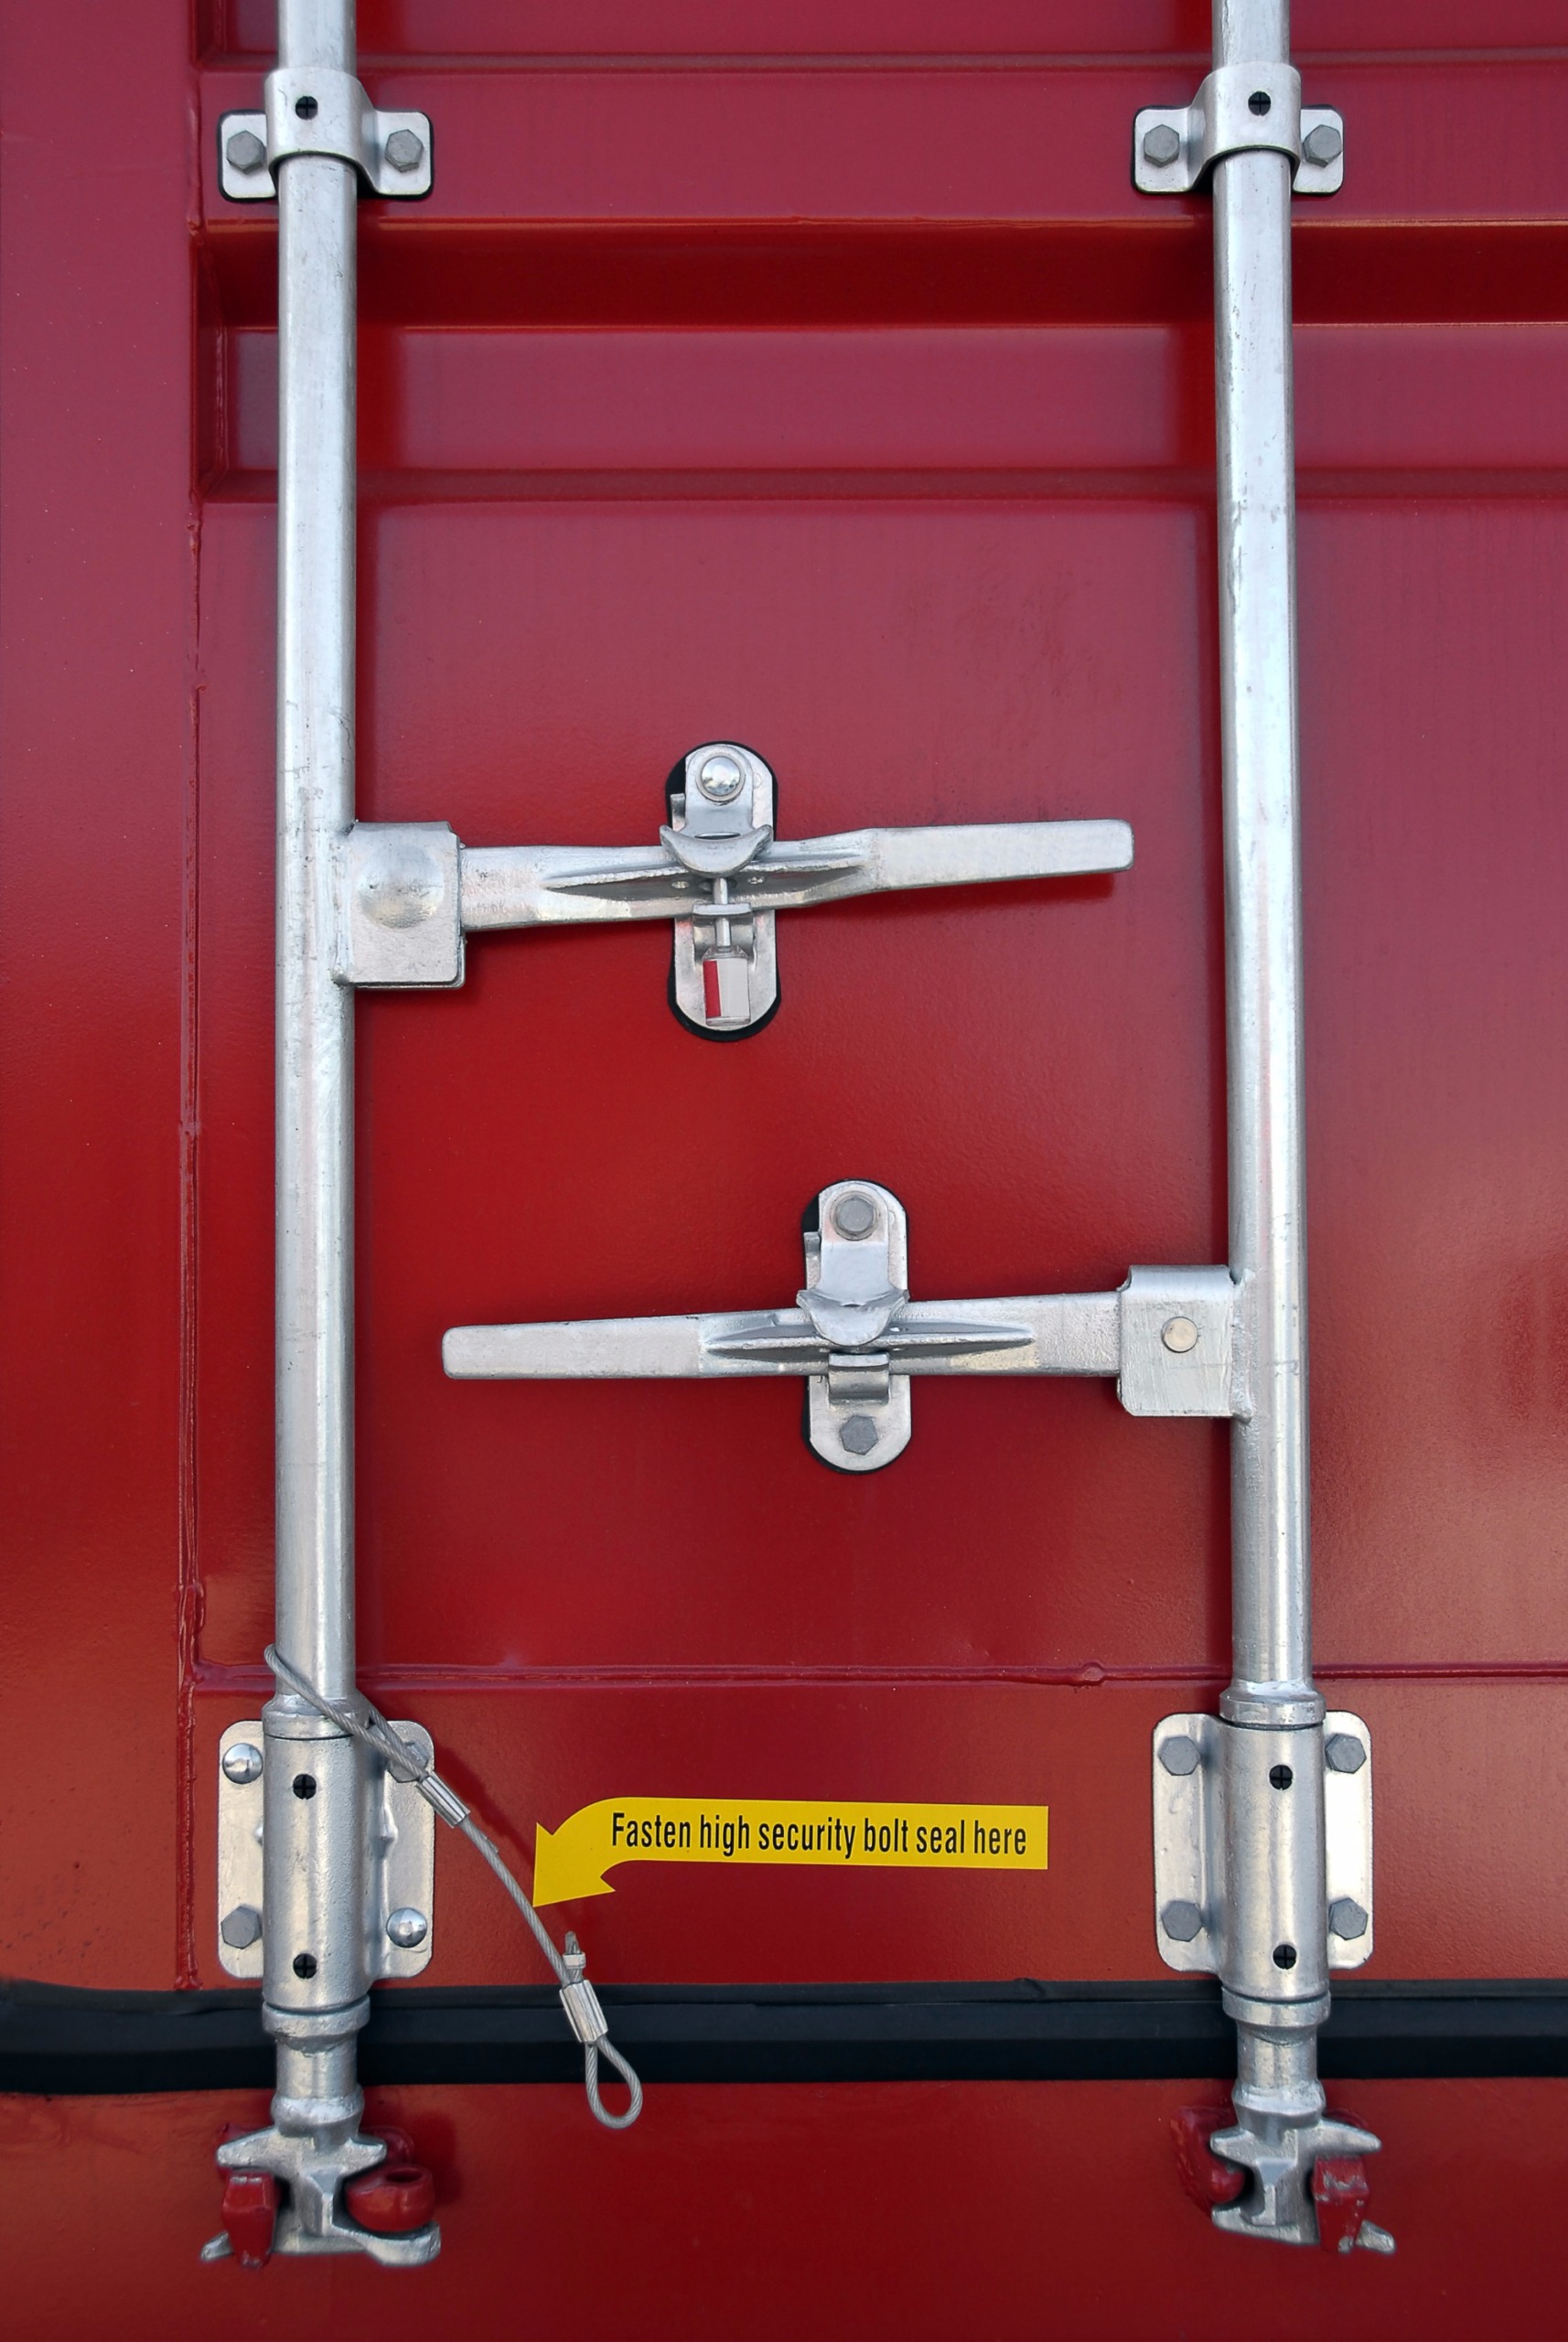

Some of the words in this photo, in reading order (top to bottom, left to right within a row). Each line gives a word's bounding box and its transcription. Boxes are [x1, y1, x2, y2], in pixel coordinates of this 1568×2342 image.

[612, 1812, 691, 1848] Fasten
[700, 1814, 750, 1857] high
[758, 1817, 856, 1860] security
[864, 1817, 908, 1853] bolt
[916, 1819, 965, 1853] seal
[974, 1820, 1026, 1855] here
